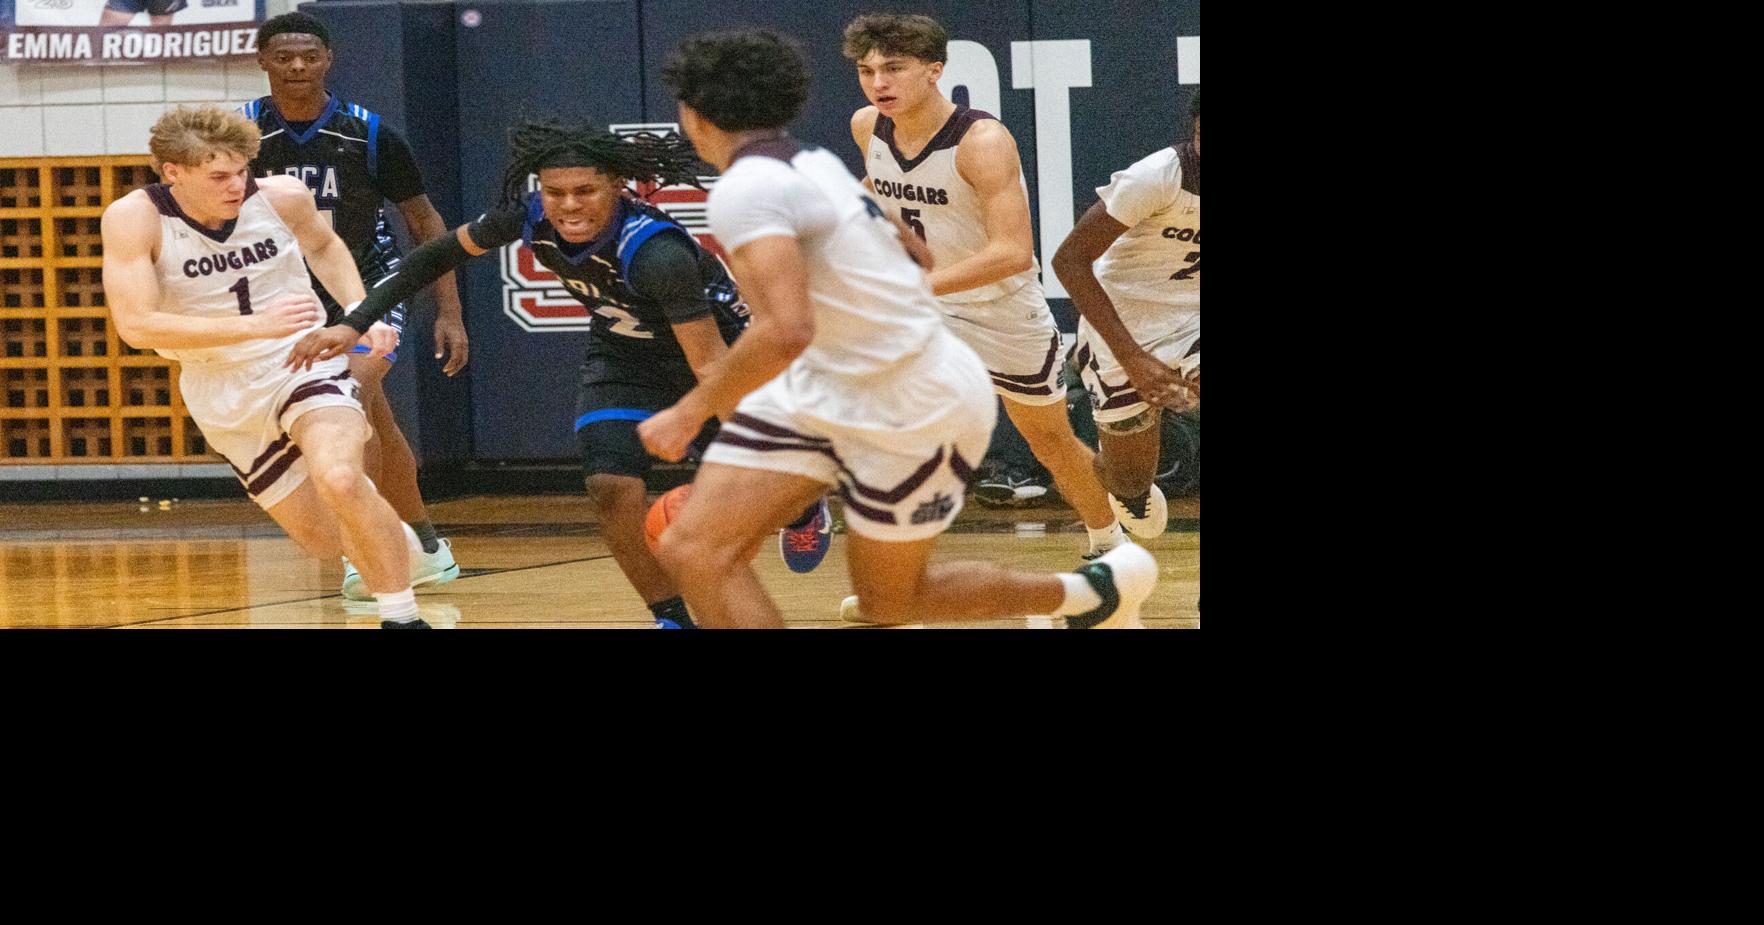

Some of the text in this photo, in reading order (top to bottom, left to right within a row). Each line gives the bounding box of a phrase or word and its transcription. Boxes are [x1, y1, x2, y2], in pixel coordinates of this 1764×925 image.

[8, 28, 258, 59] EMMA RODRIGUEZ
[874, 178, 949, 206] COUGARS
[901, 207, 926, 247] 5
[182, 238, 278, 278] COUGARS
[1168, 251, 1200, 281] 2
[229, 276, 253, 316] 1
[593, 305, 654, 339] 2
